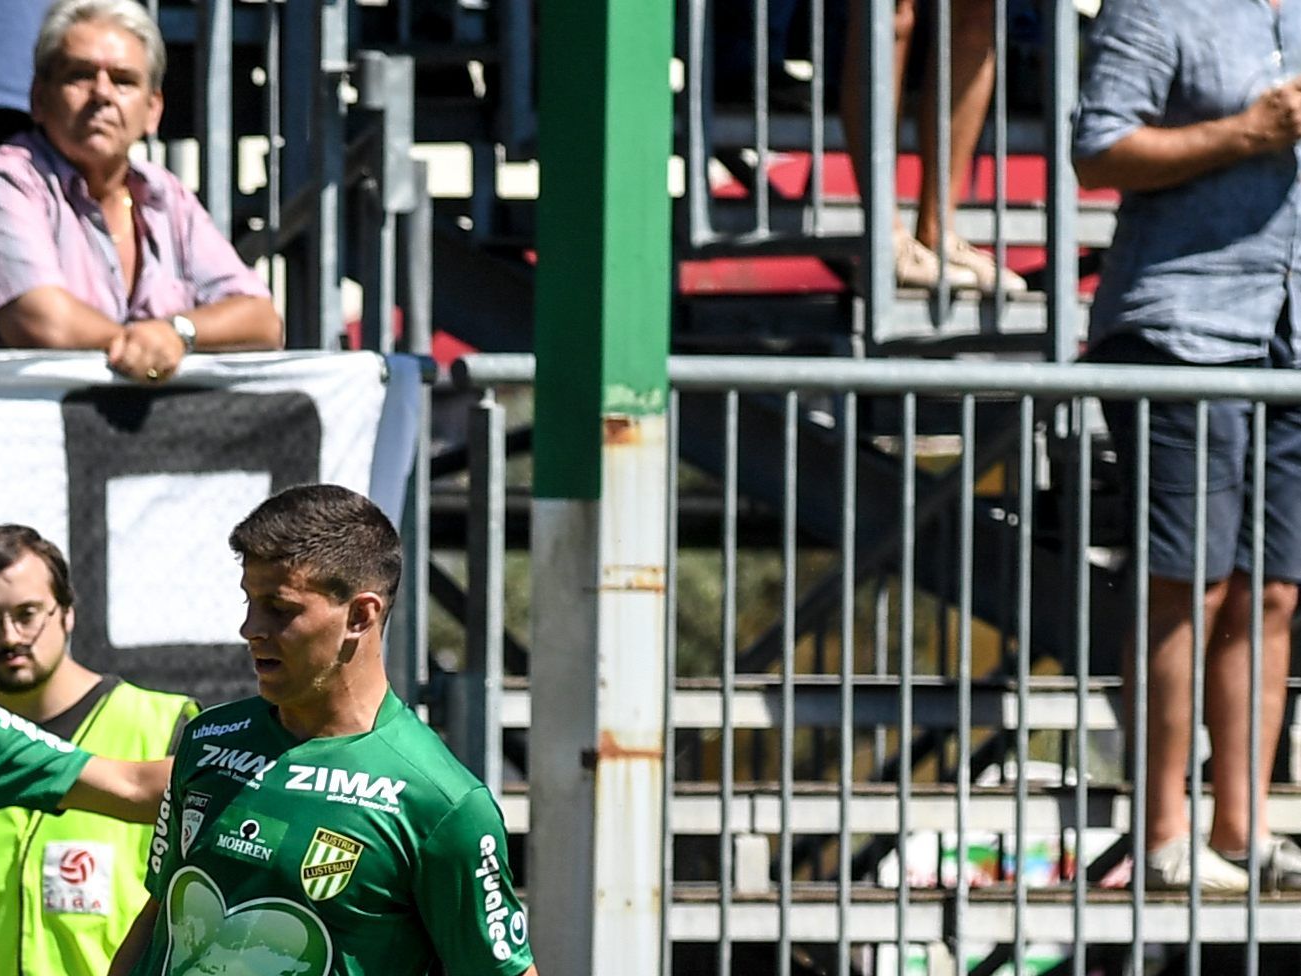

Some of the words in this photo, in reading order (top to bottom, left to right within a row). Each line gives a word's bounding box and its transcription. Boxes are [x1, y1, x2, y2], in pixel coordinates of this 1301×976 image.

[192, 718, 251, 739] uhlsport
[216, 833, 274, 861] MOHREN
[319, 833, 357, 853] AUSTRIA
[305, 861, 352, 878] LUSTENAU
[475, 834, 512, 960] equatec
